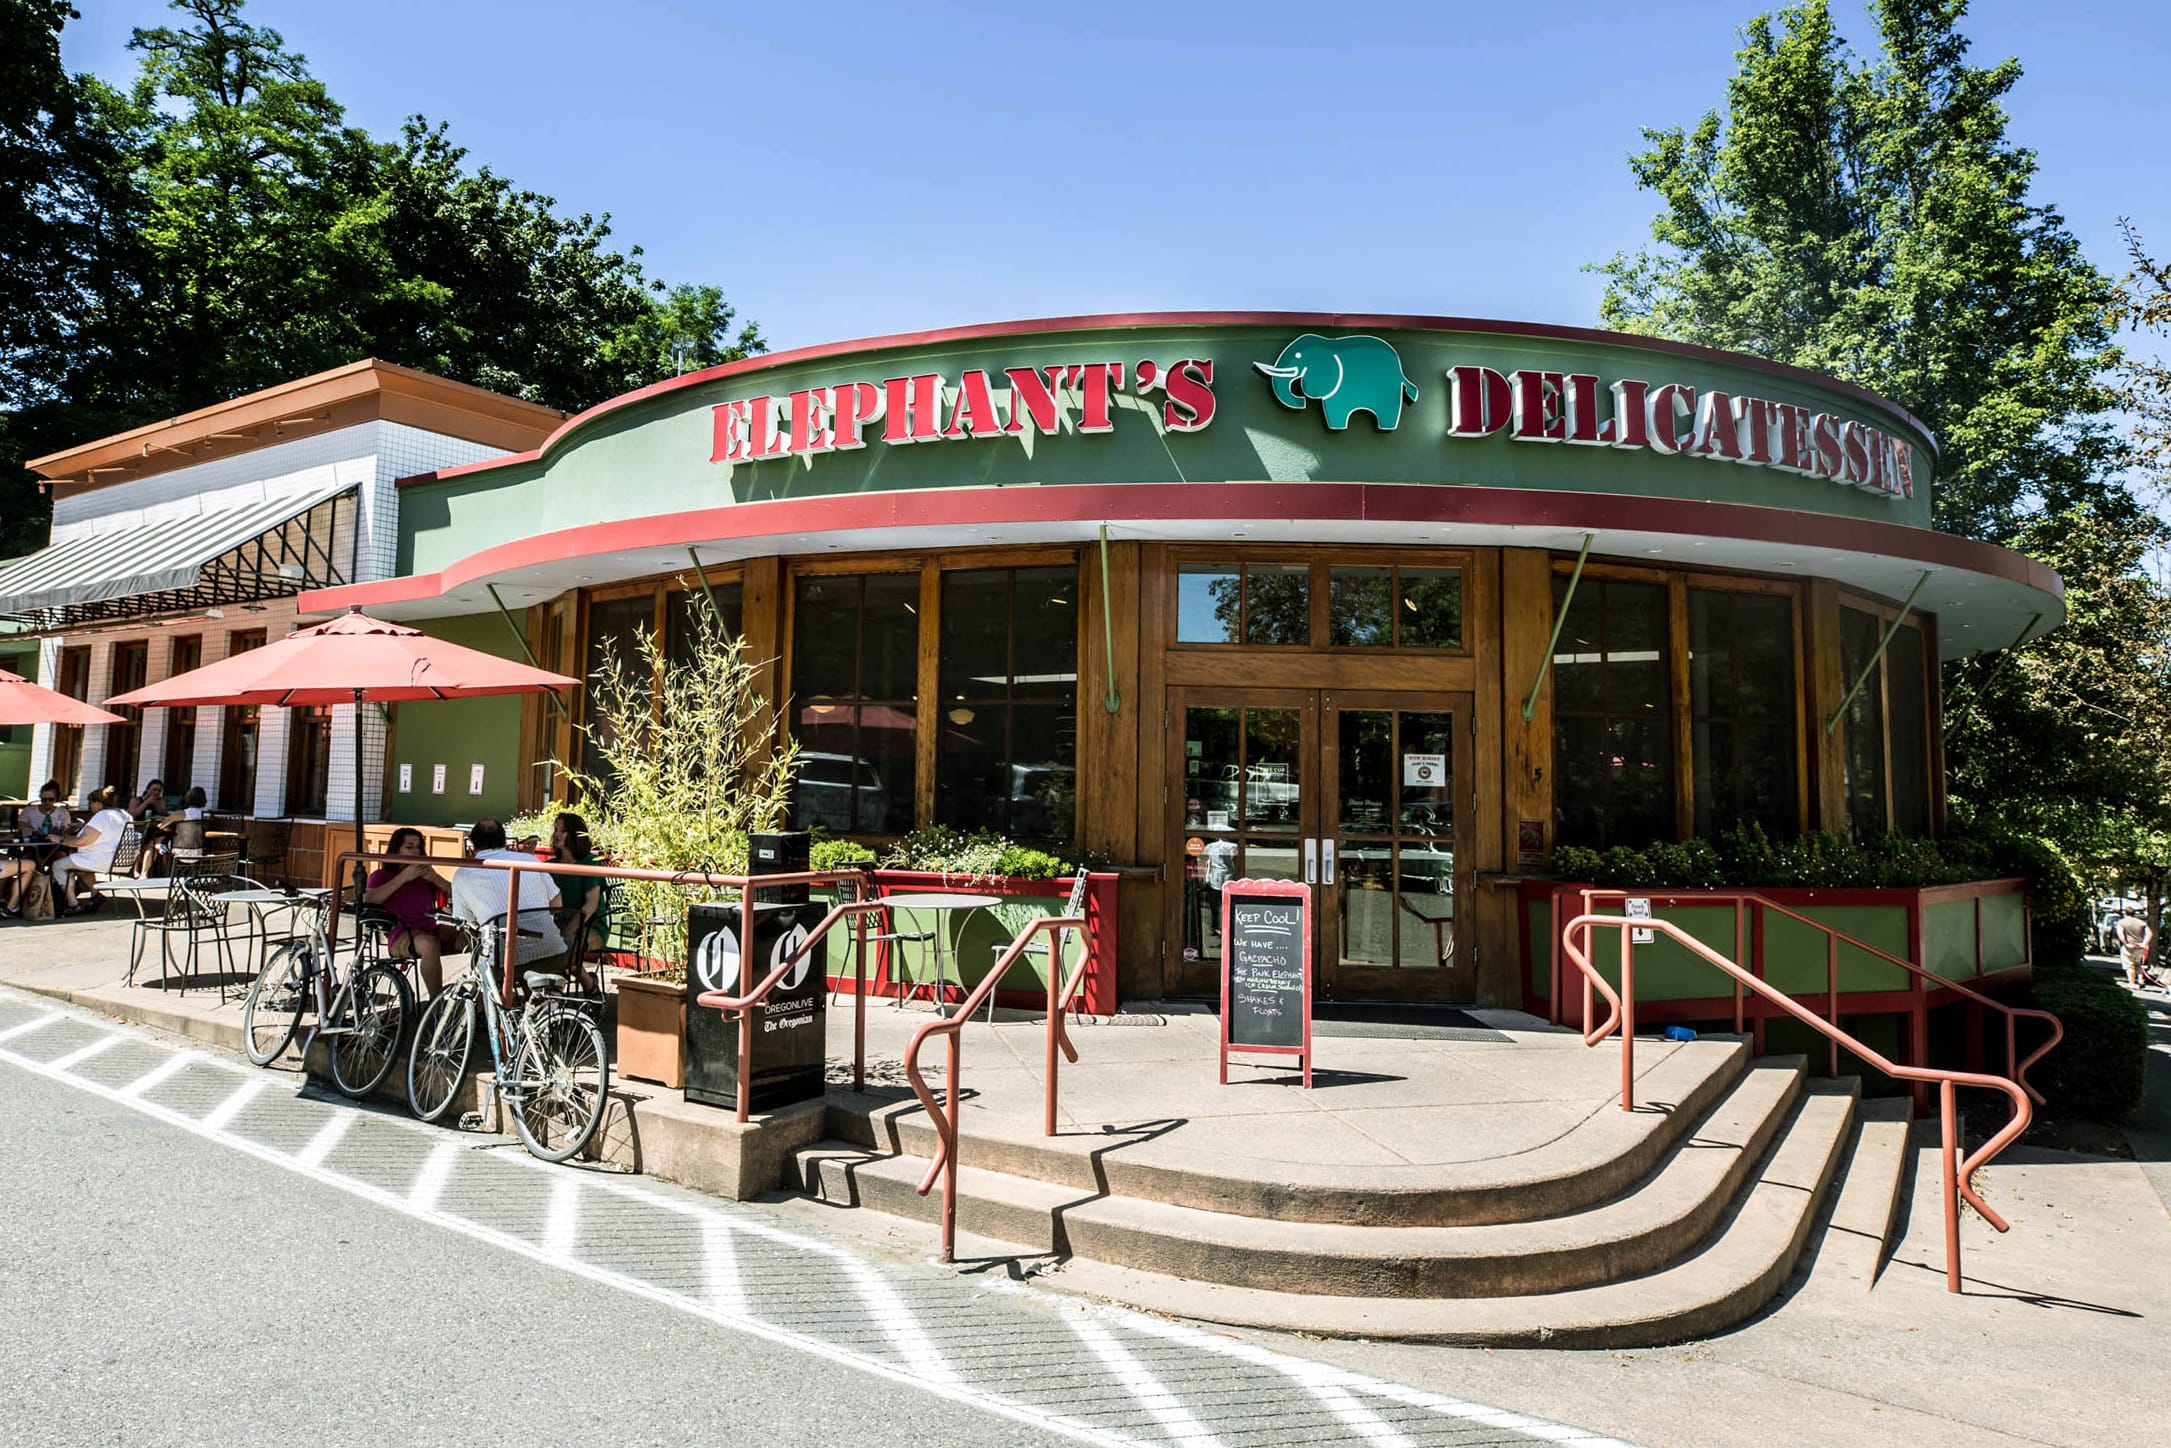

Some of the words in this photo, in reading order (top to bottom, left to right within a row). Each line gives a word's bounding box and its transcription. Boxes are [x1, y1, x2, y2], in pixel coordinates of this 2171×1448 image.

[709, 358, 1216, 464] ELEPHANT'S
[1446, 365, 1913, 499] DELICATESSEN
[1235, 908, 1261, 925] KEEP
[1239, 951, 1287, 966] GAZPACHO
[764, 997, 814, 1015] OREGONLIVE
[1238, 993, 1277, 1005] SHAKES
[1252, 1006, 1282, 1016] FLOATS
[764, 1020, 778, 1033] The
[778, 1013, 813, 1029] Oregonian
